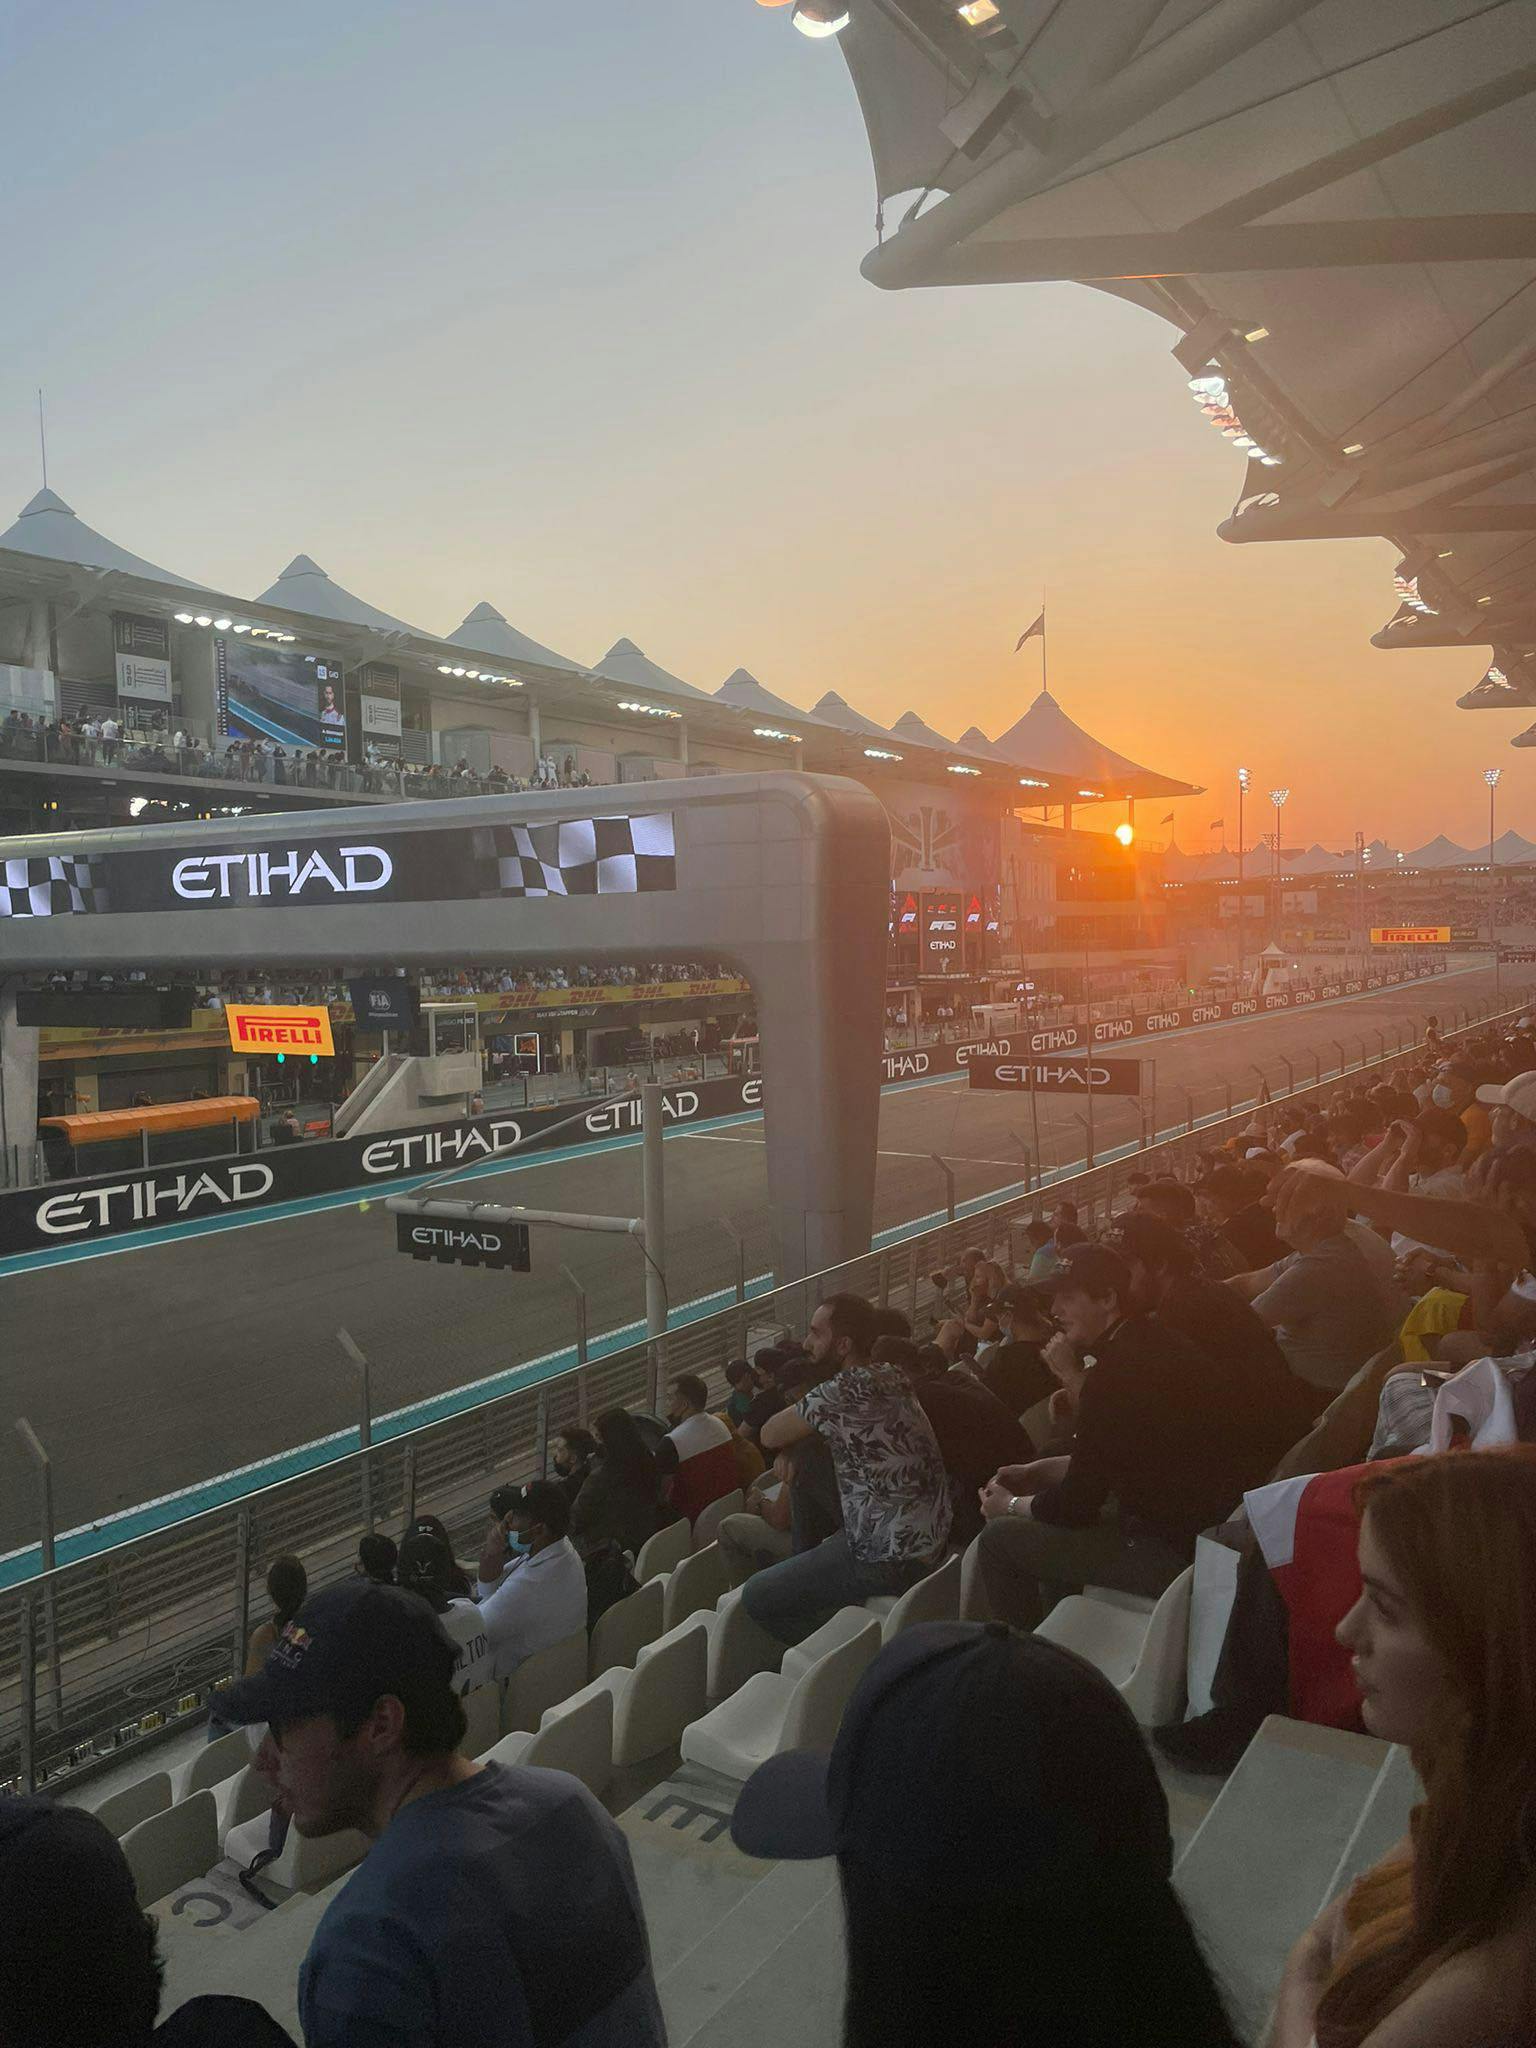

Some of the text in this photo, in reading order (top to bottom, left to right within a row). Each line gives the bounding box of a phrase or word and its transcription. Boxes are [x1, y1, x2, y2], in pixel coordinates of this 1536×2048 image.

[172, 846, 393, 899] ETIHAD
[1382, 928, 1439, 942] PIRELLI
[929, 940, 956, 950] ETIHAD
[499, 993, 540, 1008] DHL
[569, 990, 606, 1004] DHL
[1266, 994, 1288, 1008] ETIHAD
[1192, 1005, 1221, 1022] ETIHAD
[1231, 999, 1257, 1015] ETIHAD
[236, 1015, 322, 1045] PIRELLI
[1095, 1020, 1133, 1039] ETIHAD
[1146, 1012, 1180, 1030] ETIHAD
[1031, 1029, 1077, 1051] ETIHAD
[994, 1064, 1111, 1085] ETIHAD
[361, 1120, 522, 1174] ETIHAD
[35, 1163, 274, 1234] ETIHAD
[411, 1227, 501, 1251] ETIHAD
